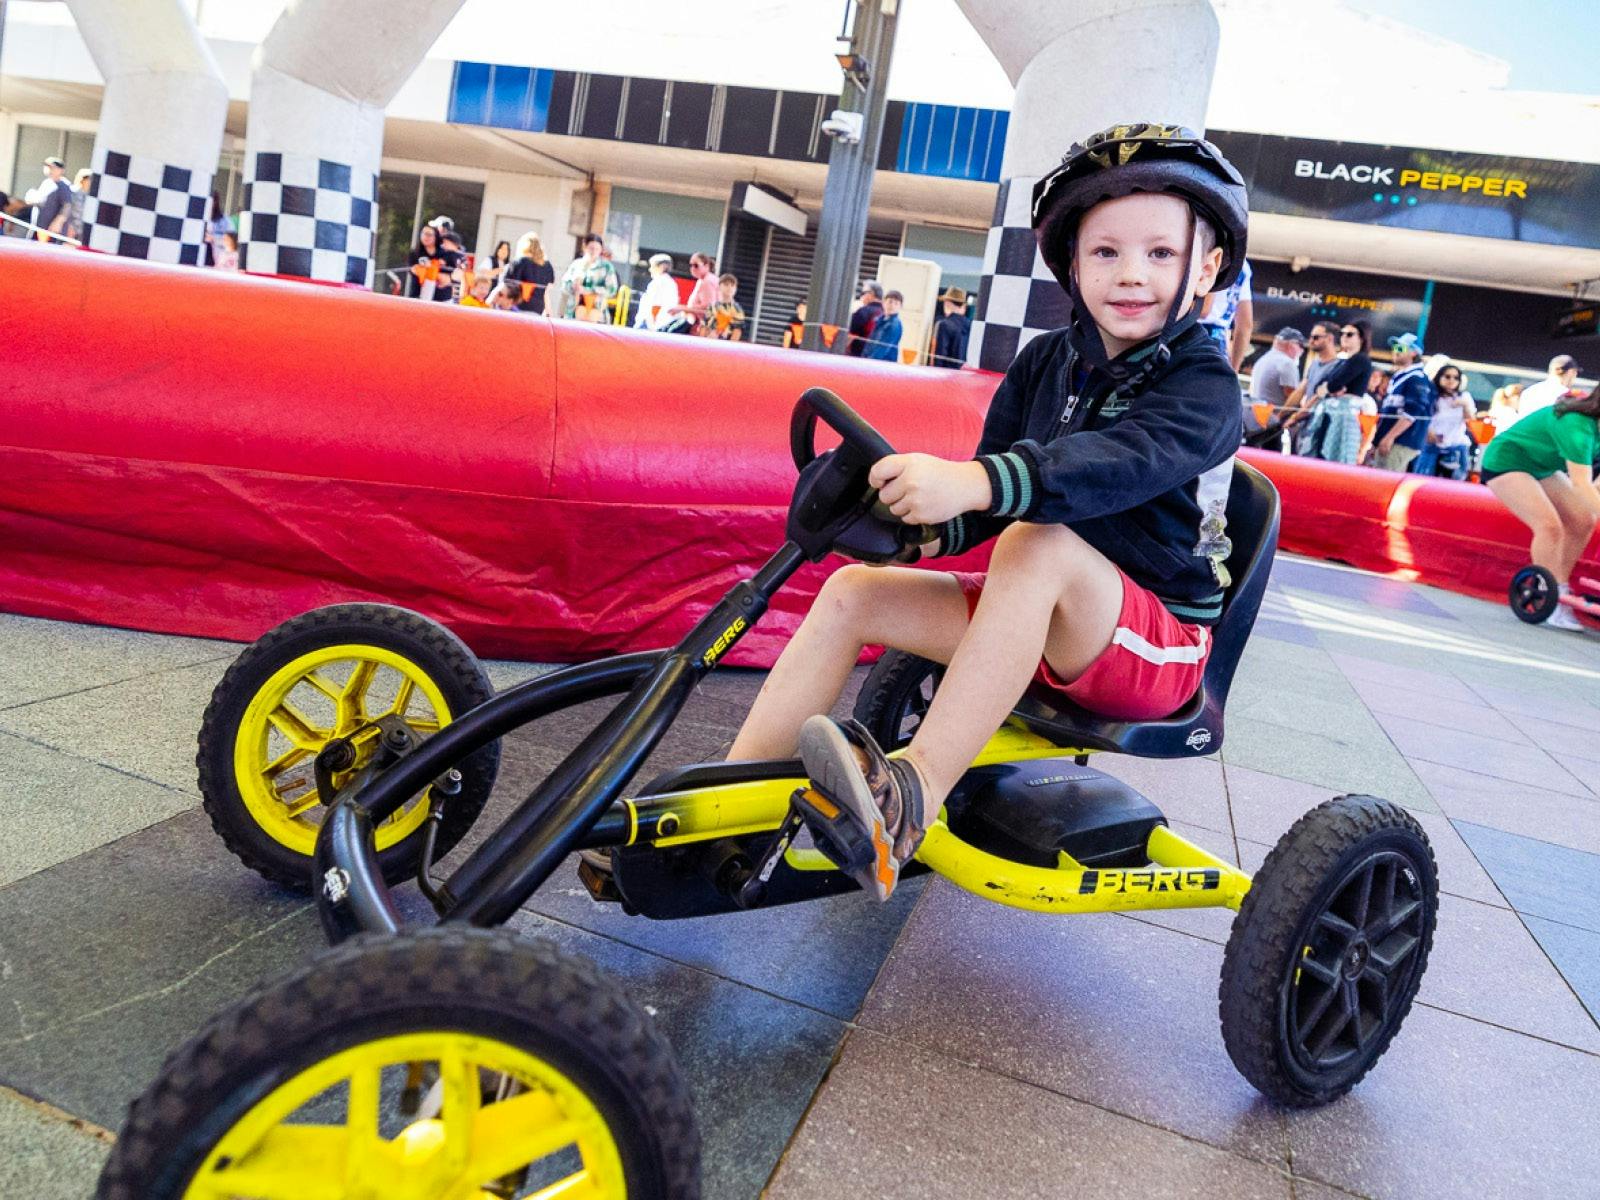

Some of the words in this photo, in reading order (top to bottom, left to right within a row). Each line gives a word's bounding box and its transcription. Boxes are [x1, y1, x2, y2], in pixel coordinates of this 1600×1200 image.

[1294, 159, 1395, 185] BLACK
[1400, 169, 1528, 198] PEPPER
[1266, 286, 1323, 304] BLACK
[703, 616, 746, 666] BERG
[1186, 732, 1211, 746] BERG
[1098, 870, 1205, 893] BERG
